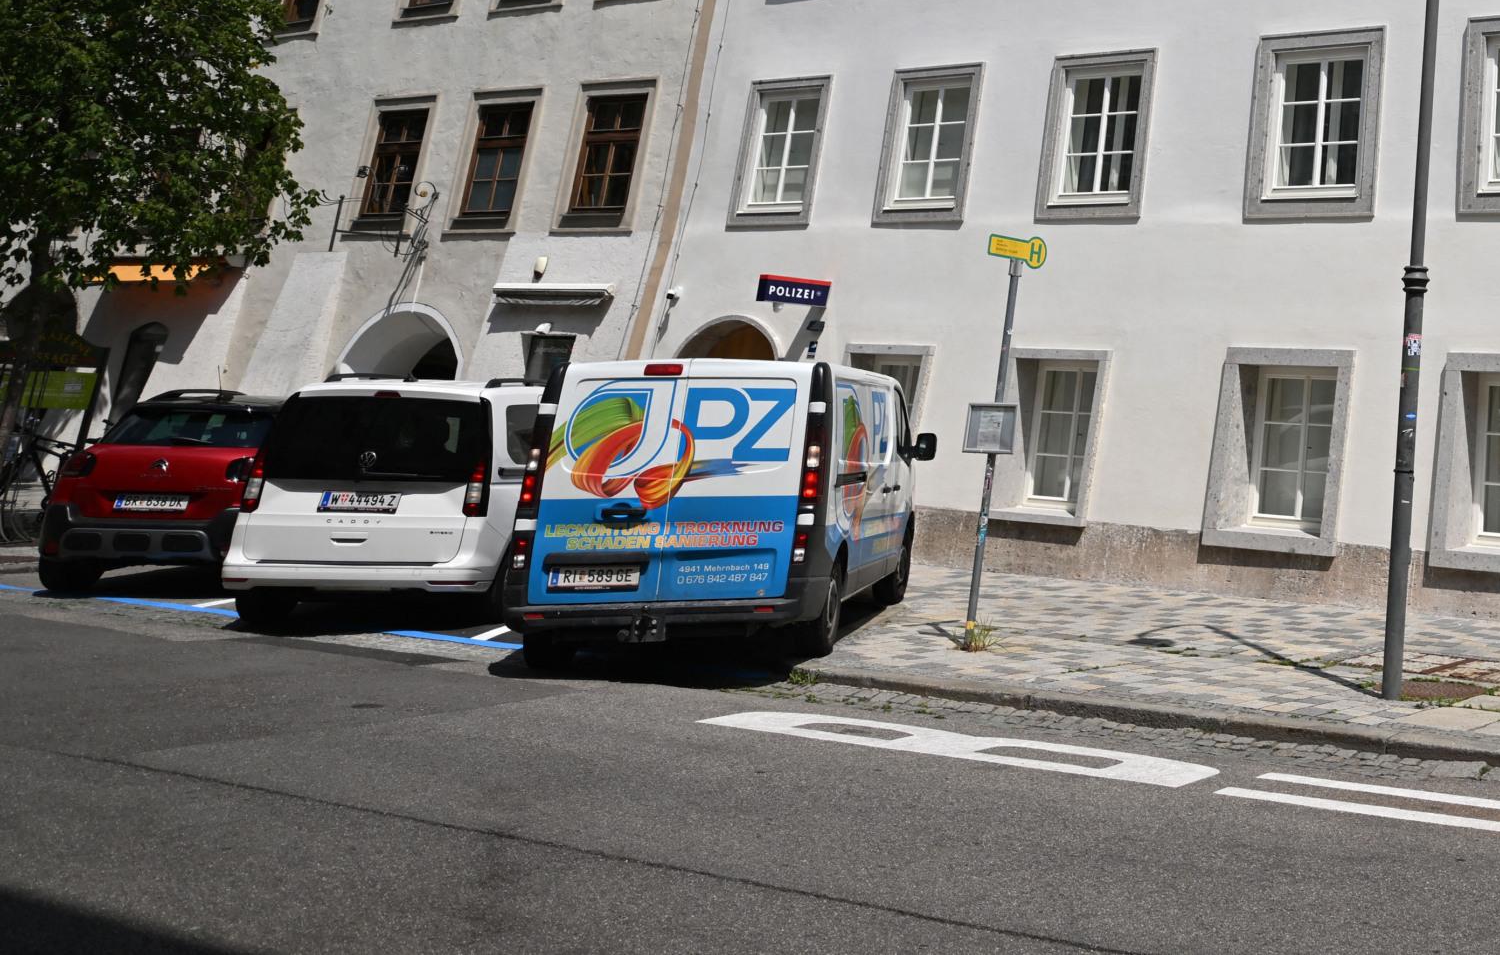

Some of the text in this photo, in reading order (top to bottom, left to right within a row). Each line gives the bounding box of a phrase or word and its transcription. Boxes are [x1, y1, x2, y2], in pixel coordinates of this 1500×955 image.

[1029, 242, 1043, 263] H
[768, 285, 815, 299] POLIZEI
[125, 496, 140, 506] BR
[169, 496, 183, 507] DK
[331, 494, 396, 506] W 44494 Z
[675, 521, 784, 534] TROCKNUNG
[566, 534, 759, 550] SCHADEN SANIERUNG
[679, 563, 769, 573] 4941 Mehrnbach 149
[563, 569, 633, 583] RI 589 GE
[749, 573, 768, 582] 847
